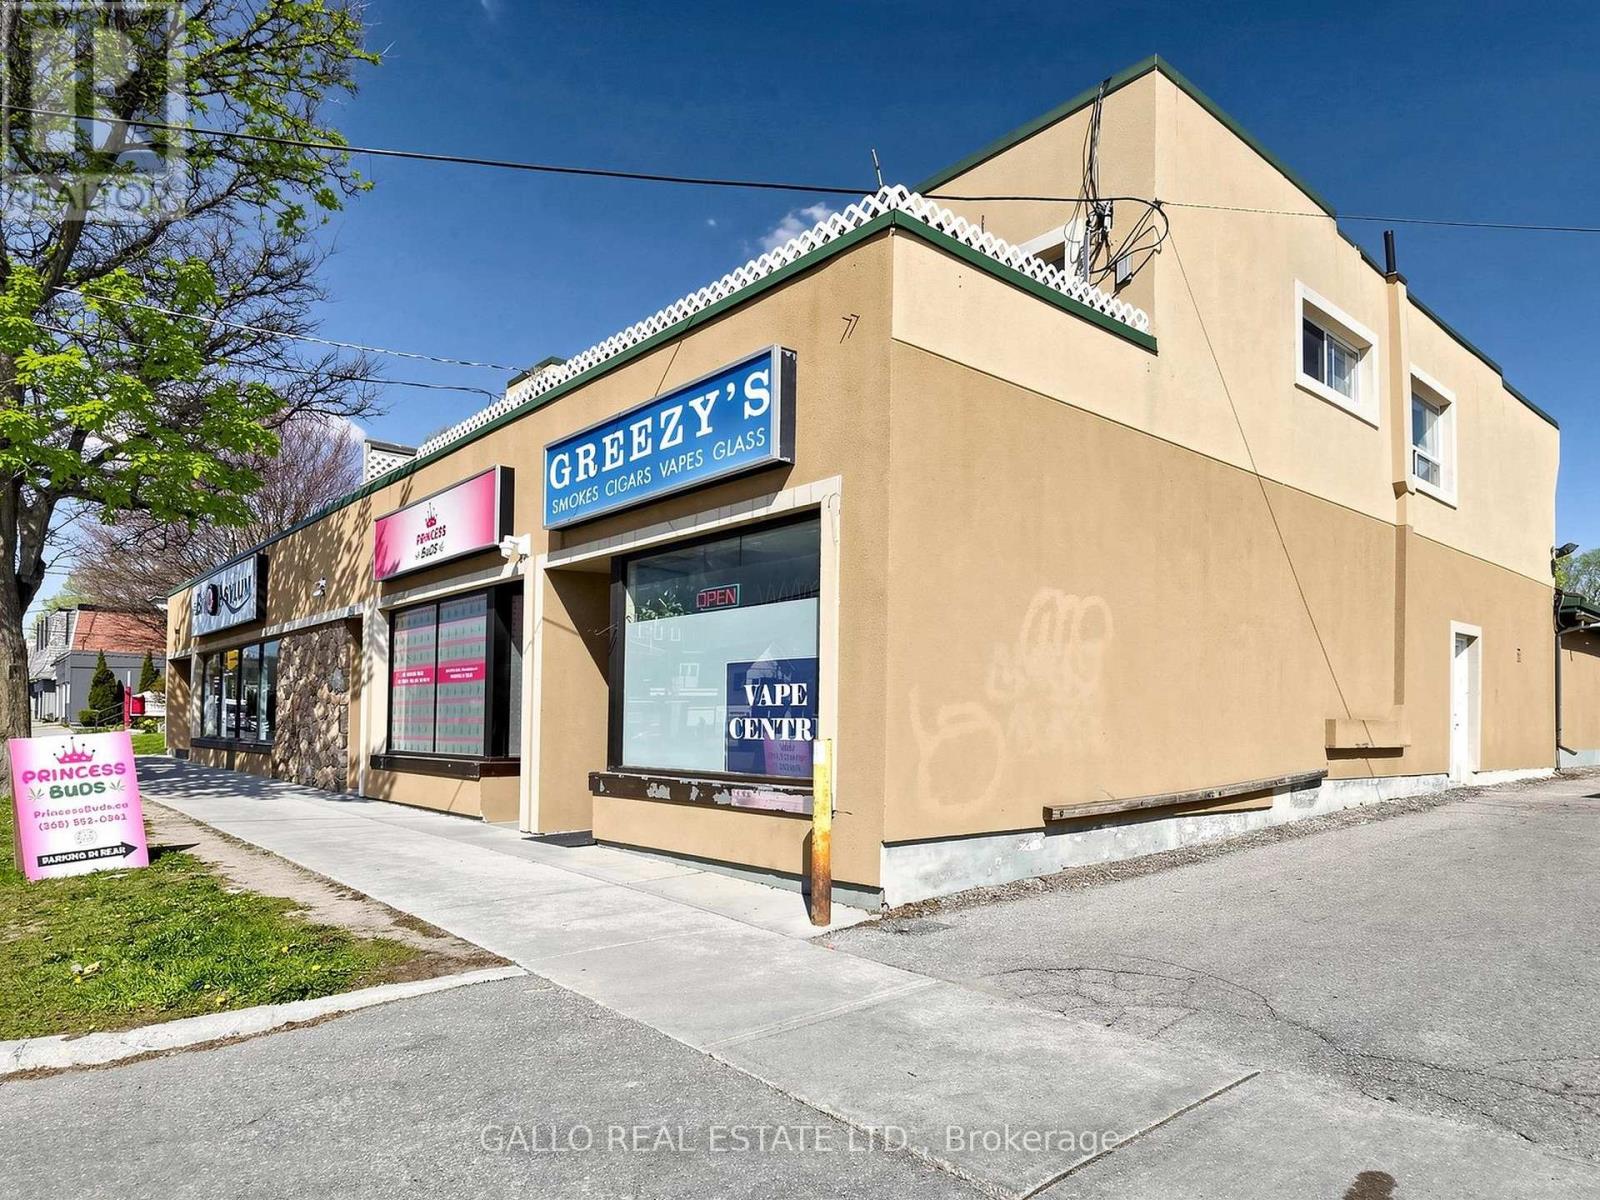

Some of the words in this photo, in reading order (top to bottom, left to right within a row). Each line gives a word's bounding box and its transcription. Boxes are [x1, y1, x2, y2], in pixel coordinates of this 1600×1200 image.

[549, 368, 771, 490] GREEZY'S
[552, 487, 599, 515] SMOKES
[605, 467, 652, 497] CIGARS
[659, 448, 704, 478] VAPES
[712, 427, 766, 461] GLASS
[416, 525, 447, 546] PRINCESS
[696, 588, 737, 609] OPEN
[744, 683, 808, 707] VAPE
[729, 717, 817, 741] CENTR
[22, 762, 127, 785] PRINCESS
[41, 852, 87, 865] PARKING
[88, 850, 99, 859] IN
[100, 846, 126, 857] REAR
